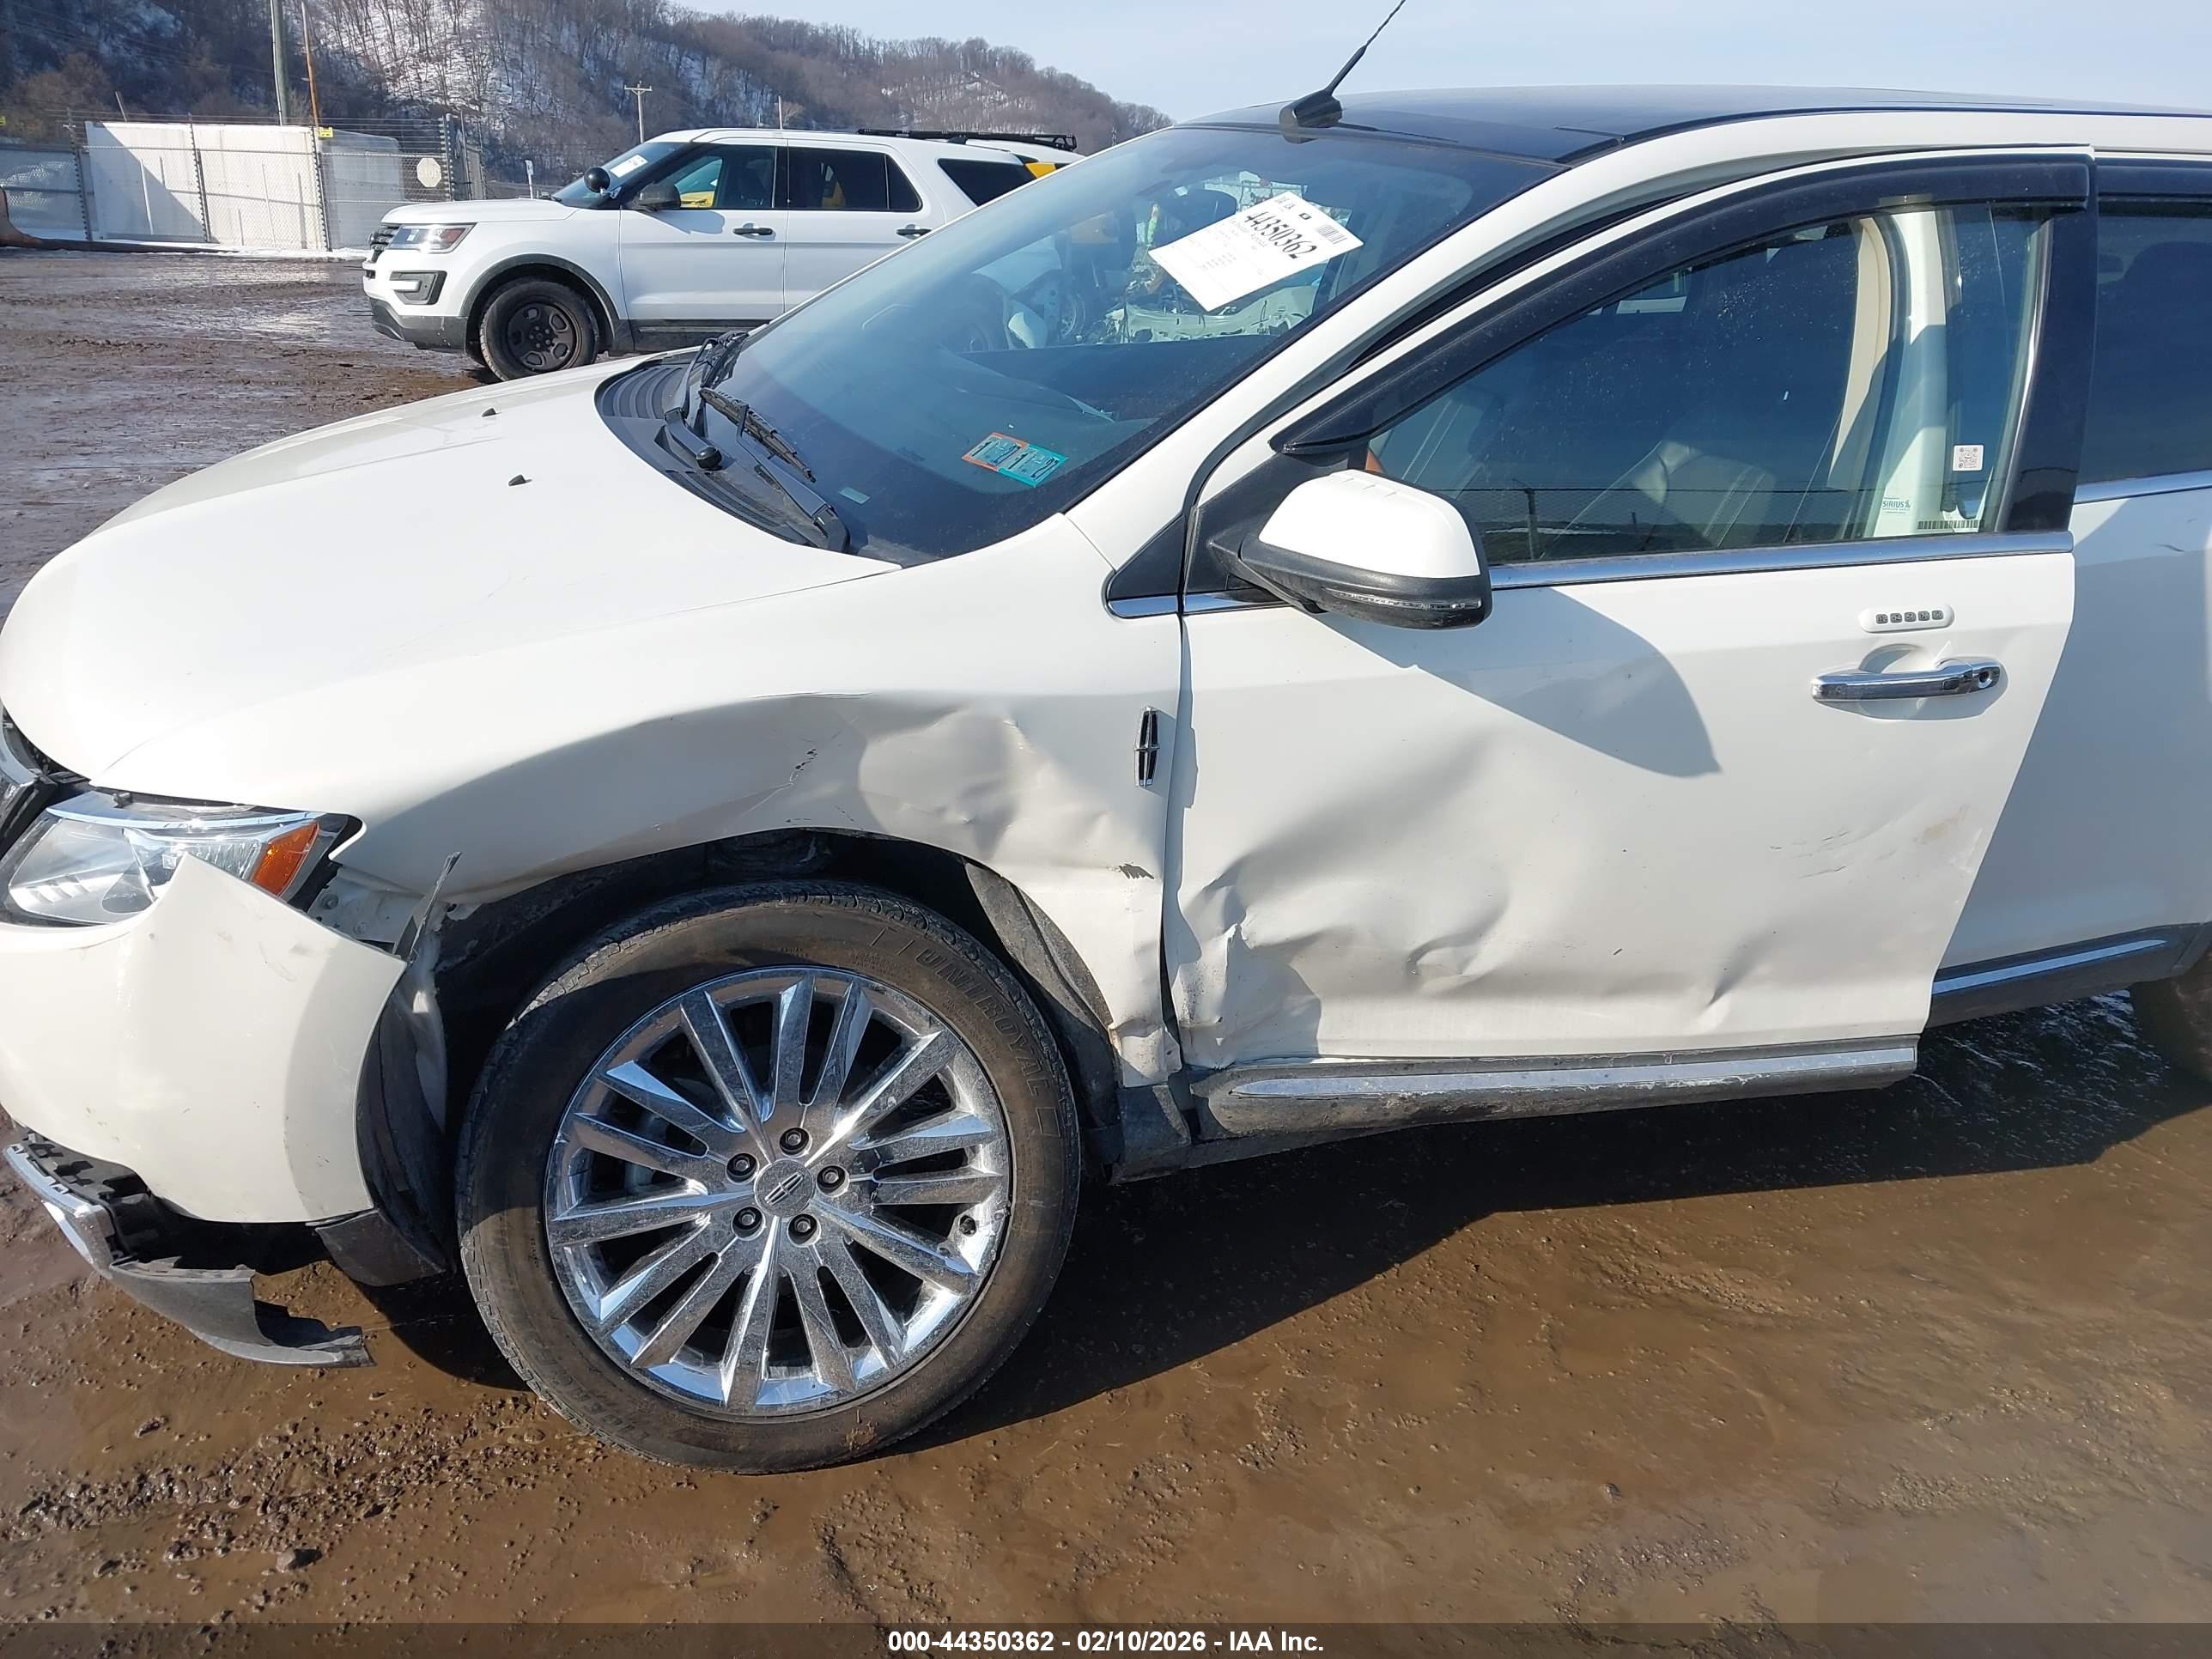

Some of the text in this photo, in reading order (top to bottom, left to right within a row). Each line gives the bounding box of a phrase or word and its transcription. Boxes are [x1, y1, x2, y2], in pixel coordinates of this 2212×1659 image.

[1244, 211, 1317, 258] 44350362
[1882, 500, 1905, 508] SIRIUS
[915, 948, 1048, 1097] UNIROYAL
